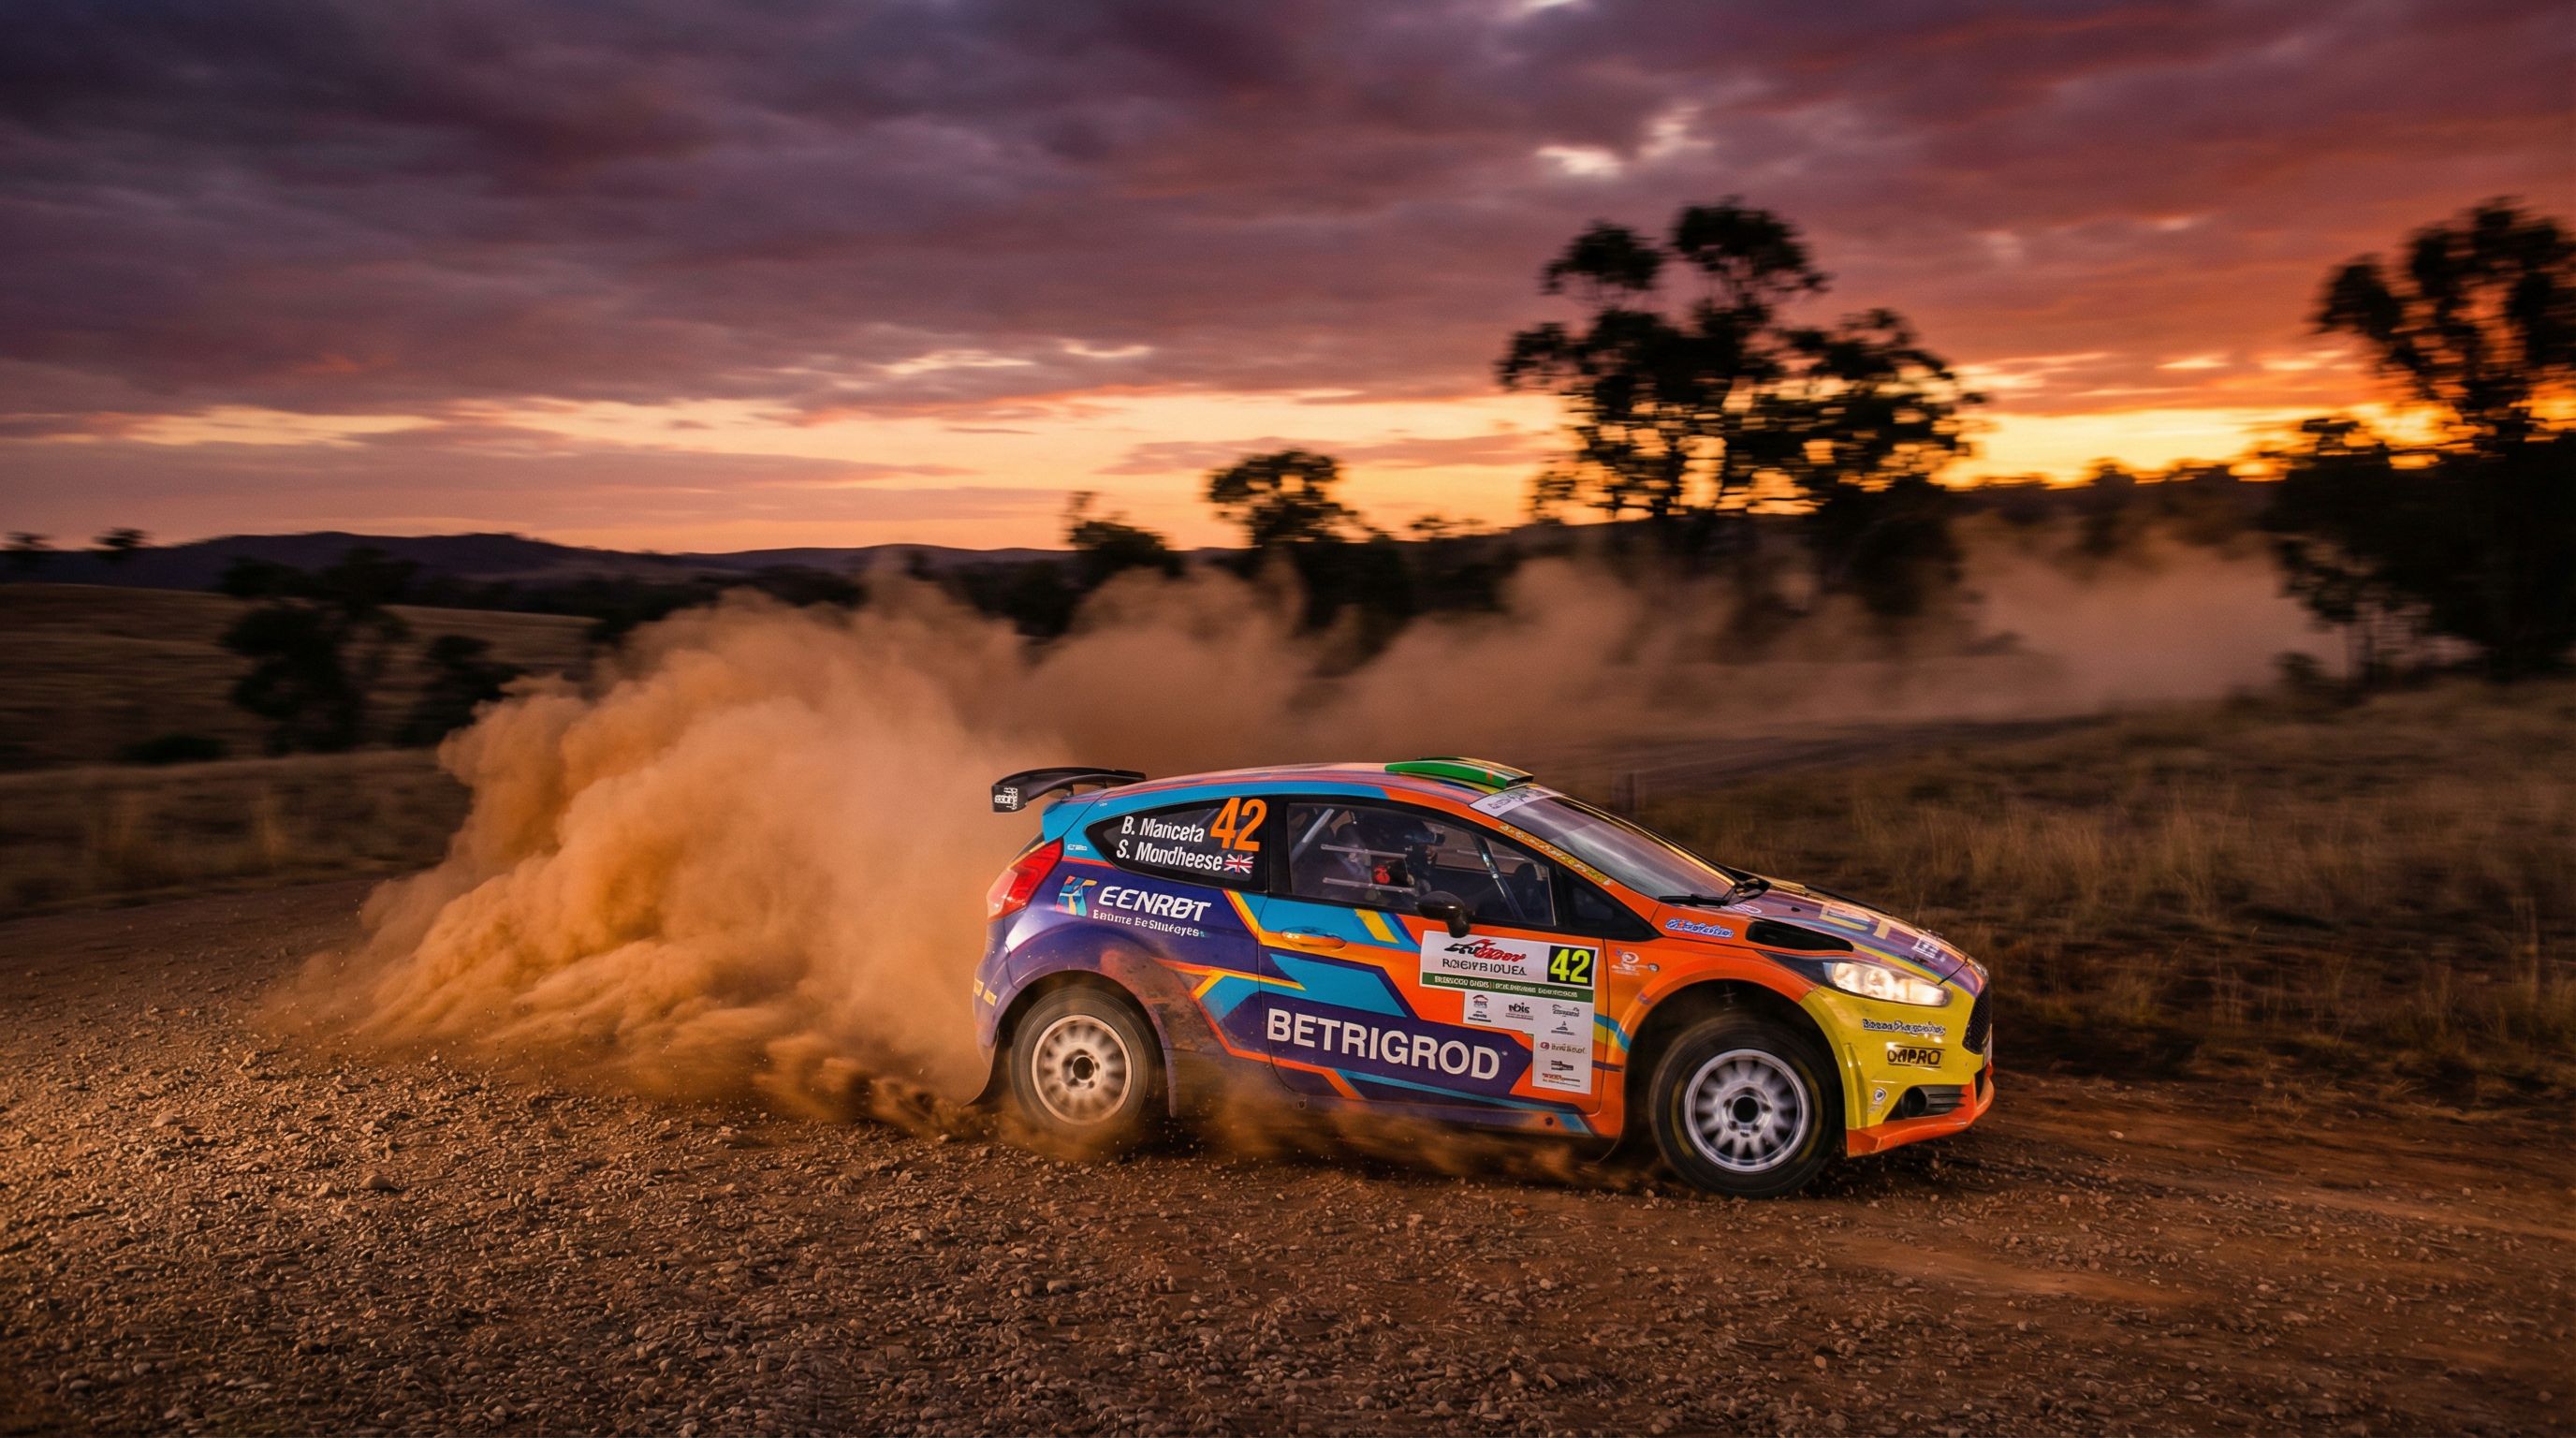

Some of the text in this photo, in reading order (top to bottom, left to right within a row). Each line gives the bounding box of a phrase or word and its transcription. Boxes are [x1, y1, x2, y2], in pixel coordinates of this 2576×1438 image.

[1121, 816, 1135, 835] B.
[1210, 798, 1266, 852] 42
[1117, 840, 1222, 872] S. Mondheese
[1549, 948, 1590, 983] 42
[1266, 1007, 1500, 1080] BETRIGROD
